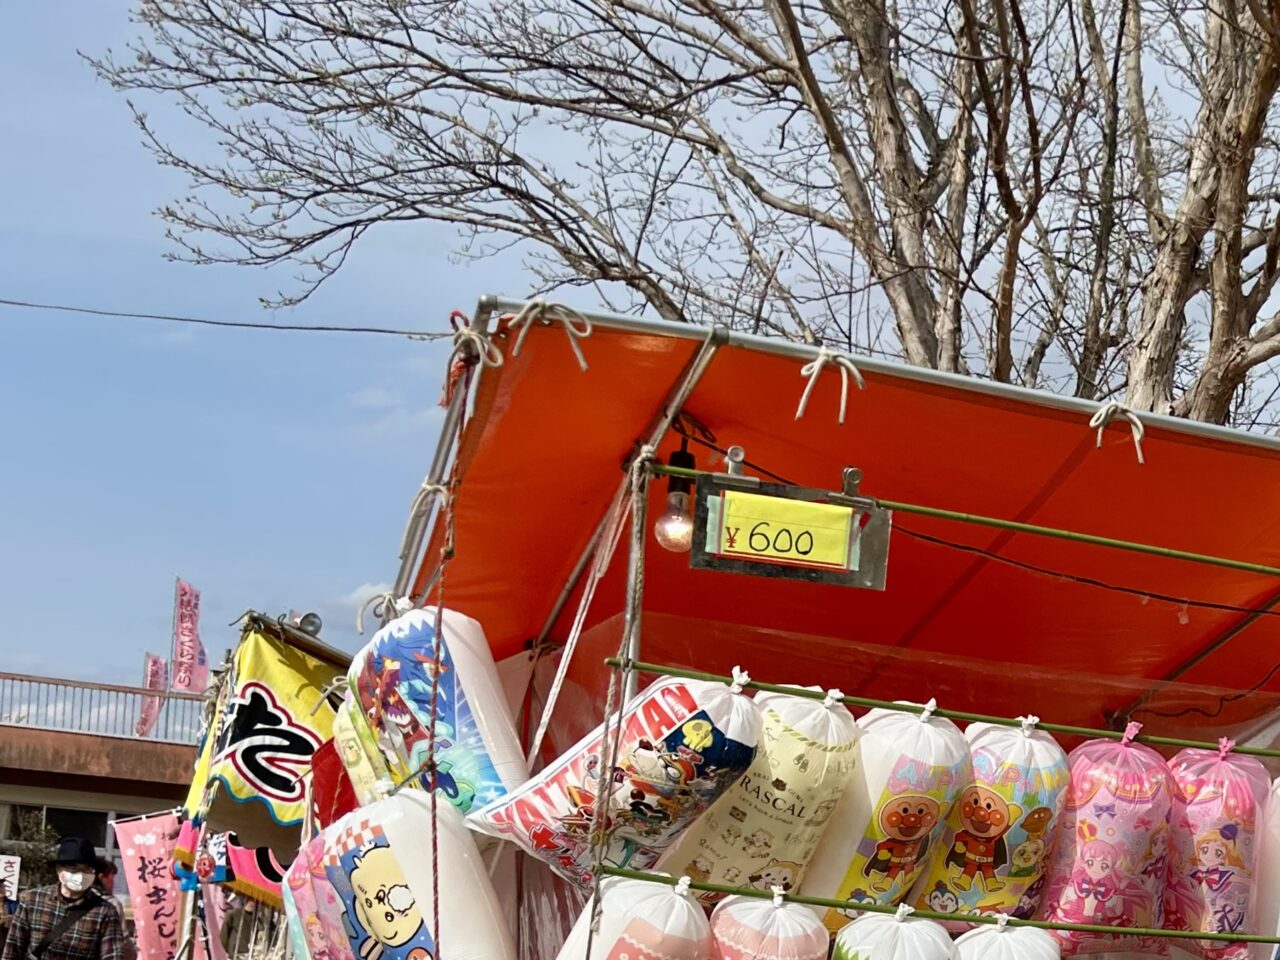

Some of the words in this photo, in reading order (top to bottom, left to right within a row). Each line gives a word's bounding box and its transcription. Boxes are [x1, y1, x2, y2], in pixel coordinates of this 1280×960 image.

[725, 526, 740, 548] ¥
[749, 521, 814, 556] 600
[738, 774, 807, 819] RASCAL
